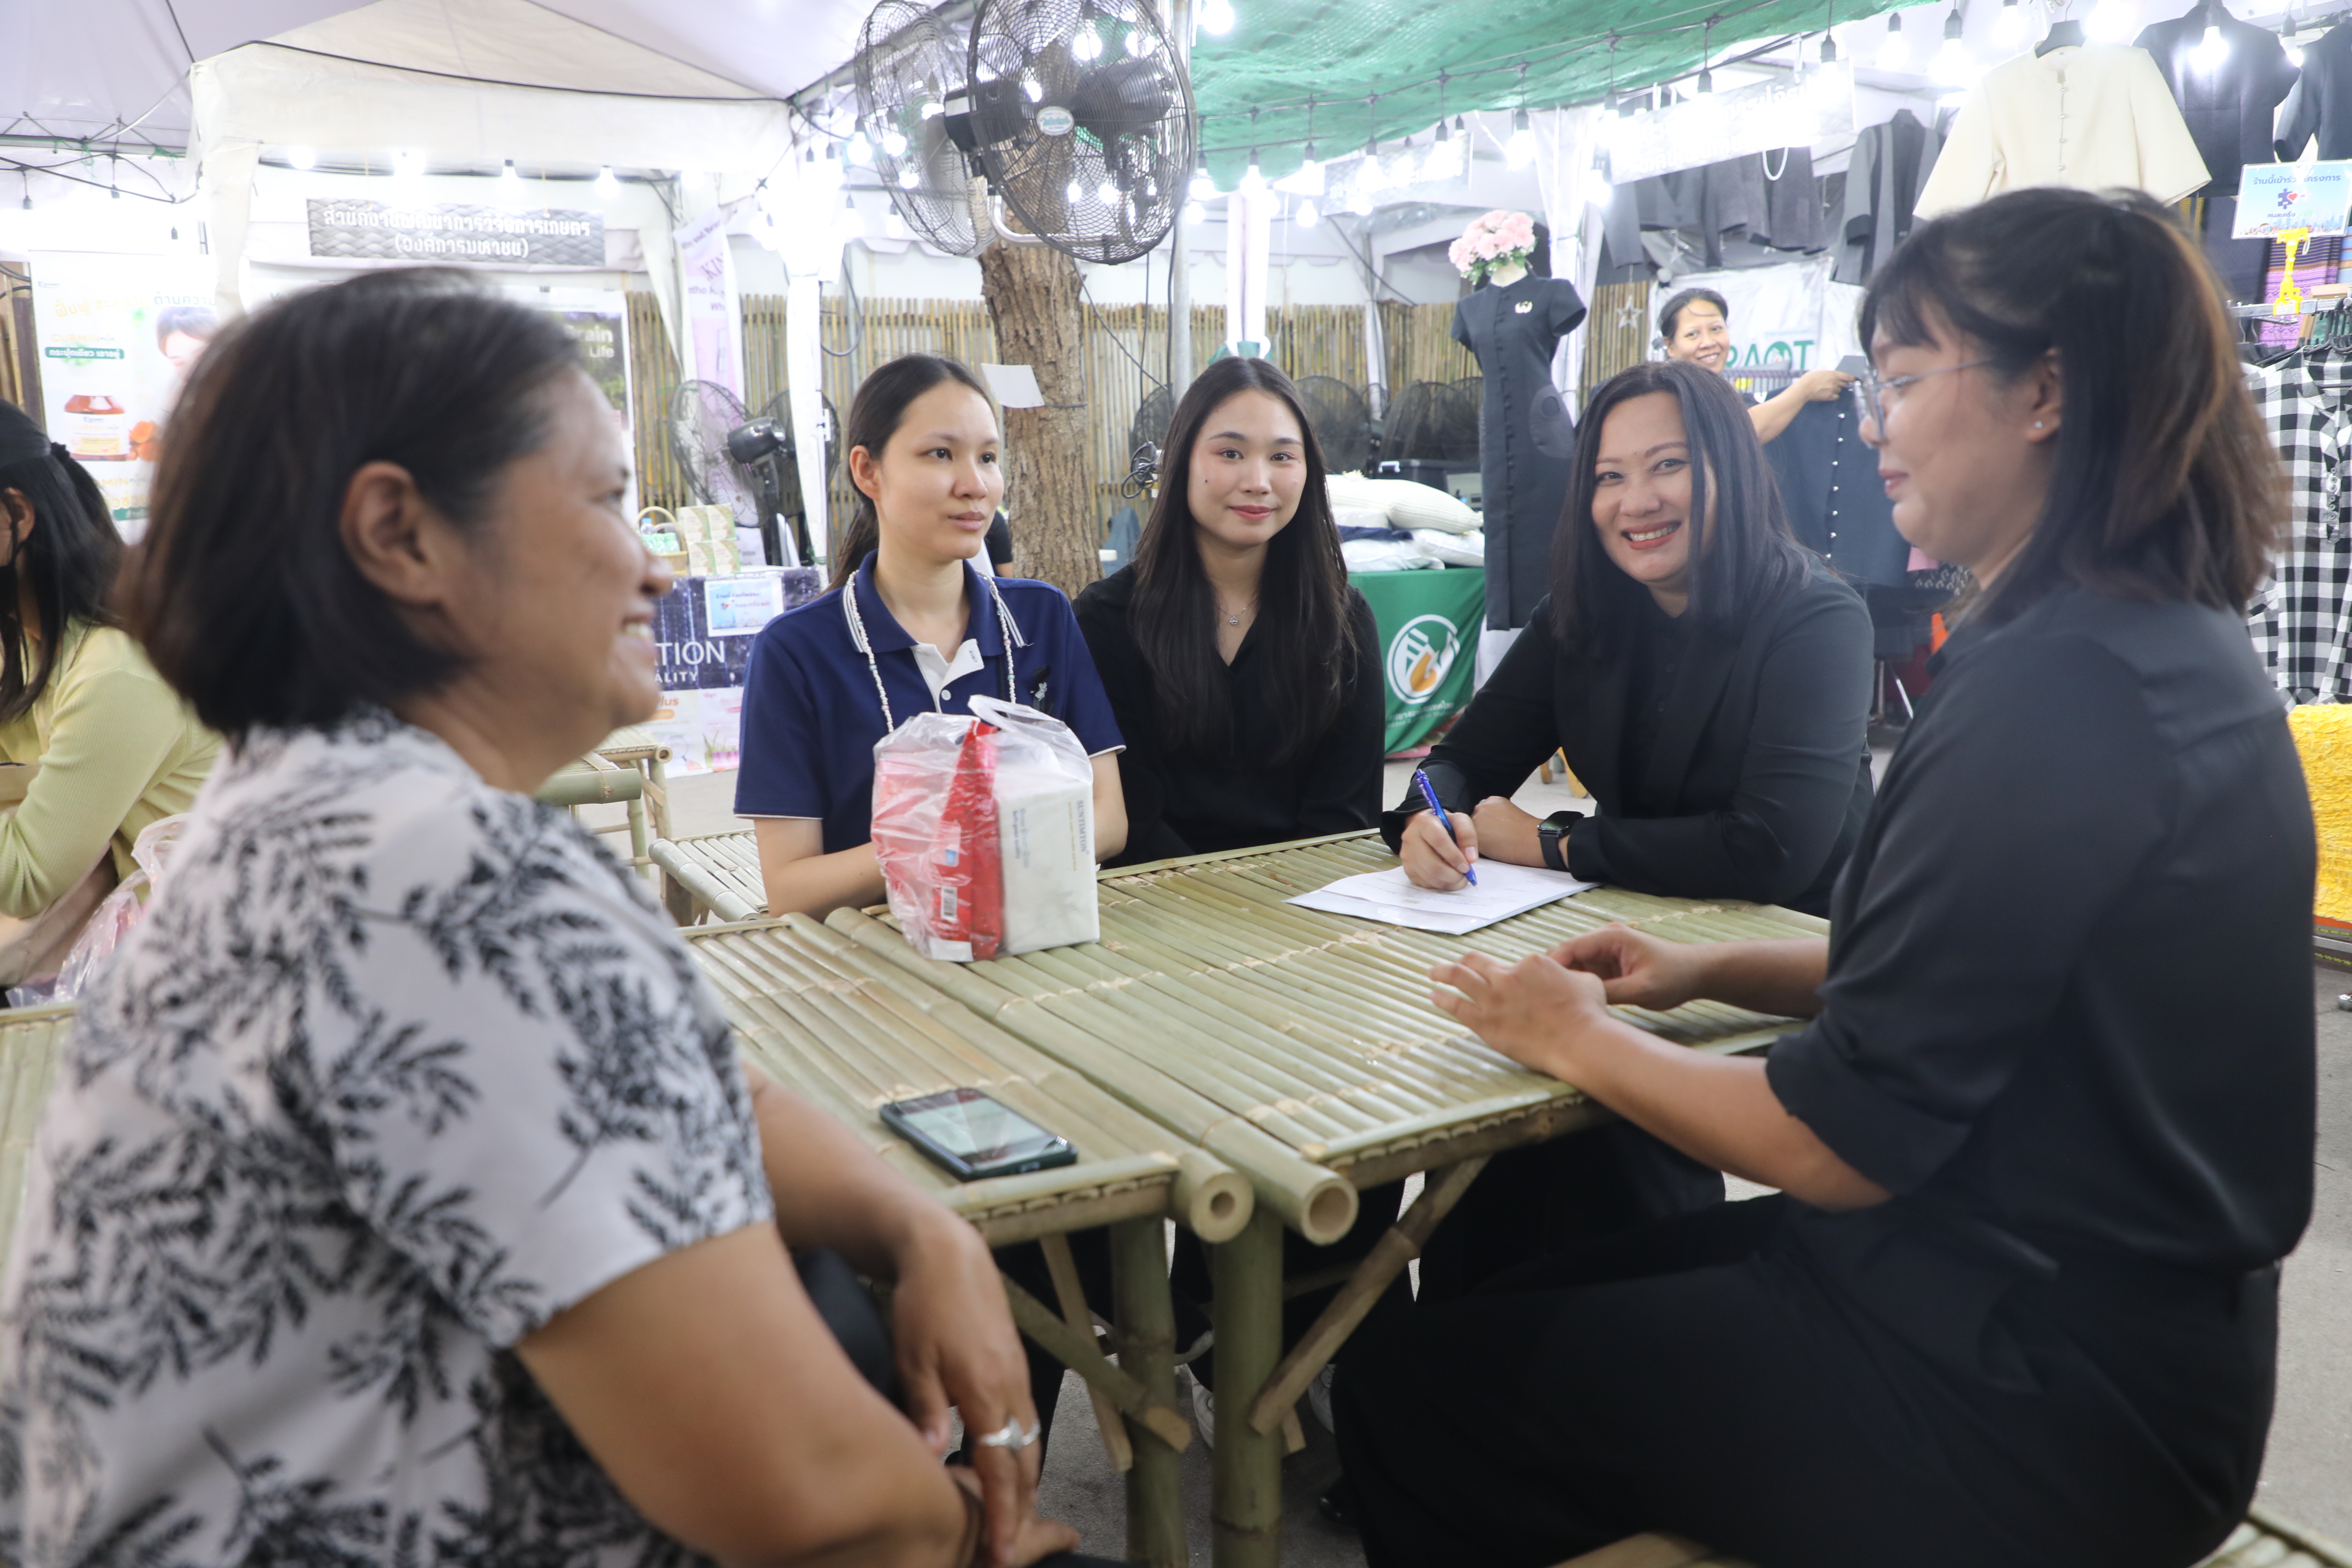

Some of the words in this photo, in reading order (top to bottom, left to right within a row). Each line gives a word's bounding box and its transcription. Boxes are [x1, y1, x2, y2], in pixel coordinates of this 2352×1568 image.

[2252, 174, 2341, 185] ร้านนี้เข้าร่วครงการ
[323, 204, 591, 237] สำนักงานพฒนาการวิจัยการเกษตร
[395, 232, 530, 259] (องค์การมหาชน)
[654, 640, 726, 667] TION
[654, 671, 698, 683] ALITY
[659, 695, 680, 707] lus
